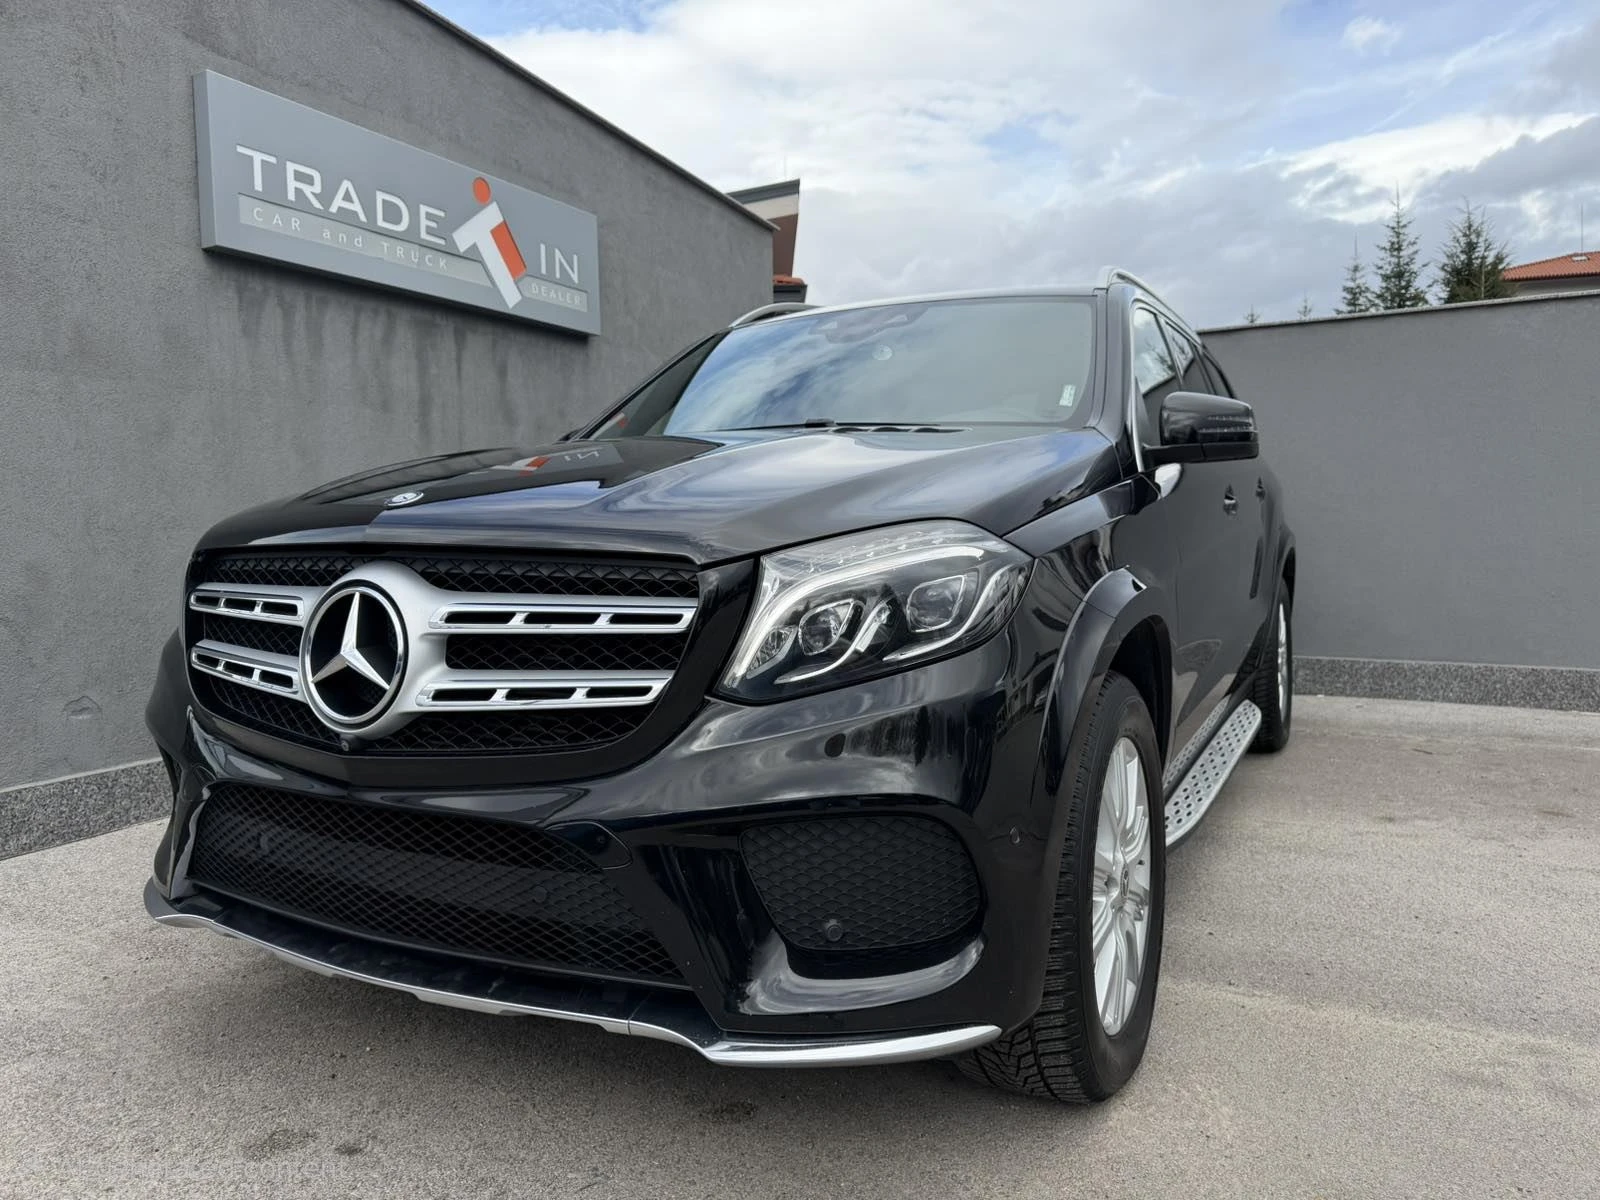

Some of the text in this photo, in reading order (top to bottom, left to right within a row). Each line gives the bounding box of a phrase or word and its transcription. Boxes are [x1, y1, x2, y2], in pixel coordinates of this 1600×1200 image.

[236, 144, 580, 284] TRADE IN
[253, 207, 302, 231] CAR
[322, 226, 363, 248] and
[380, 242, 449, 271] TRUCK
